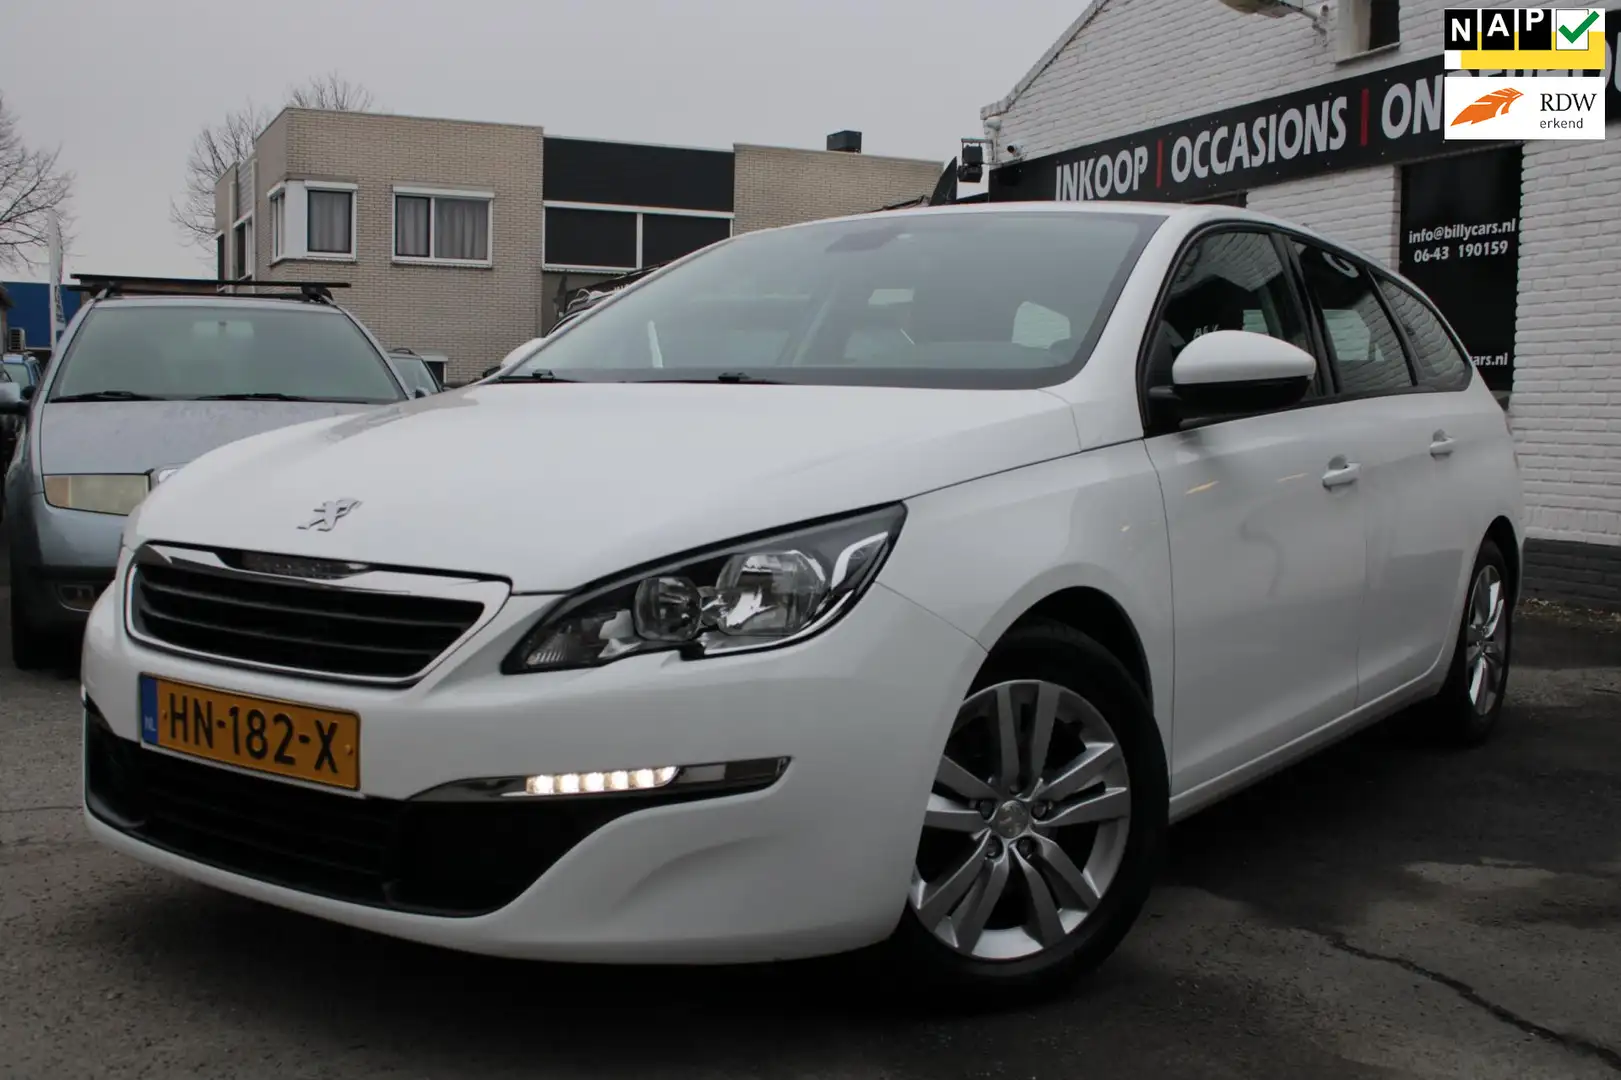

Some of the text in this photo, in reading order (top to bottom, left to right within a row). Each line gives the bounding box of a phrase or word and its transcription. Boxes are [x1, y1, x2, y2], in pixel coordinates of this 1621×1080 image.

[1055, 96, 1348, 202] INKOOP OCCASIONS
[1408, 218, 1516, 244] info@billycars.nl
[1413, 240, 1509, 263] 06-43 190159
[1470, 352, 1509, 366] ars.nl
[169, 692, 339, 774] HN-182-X
